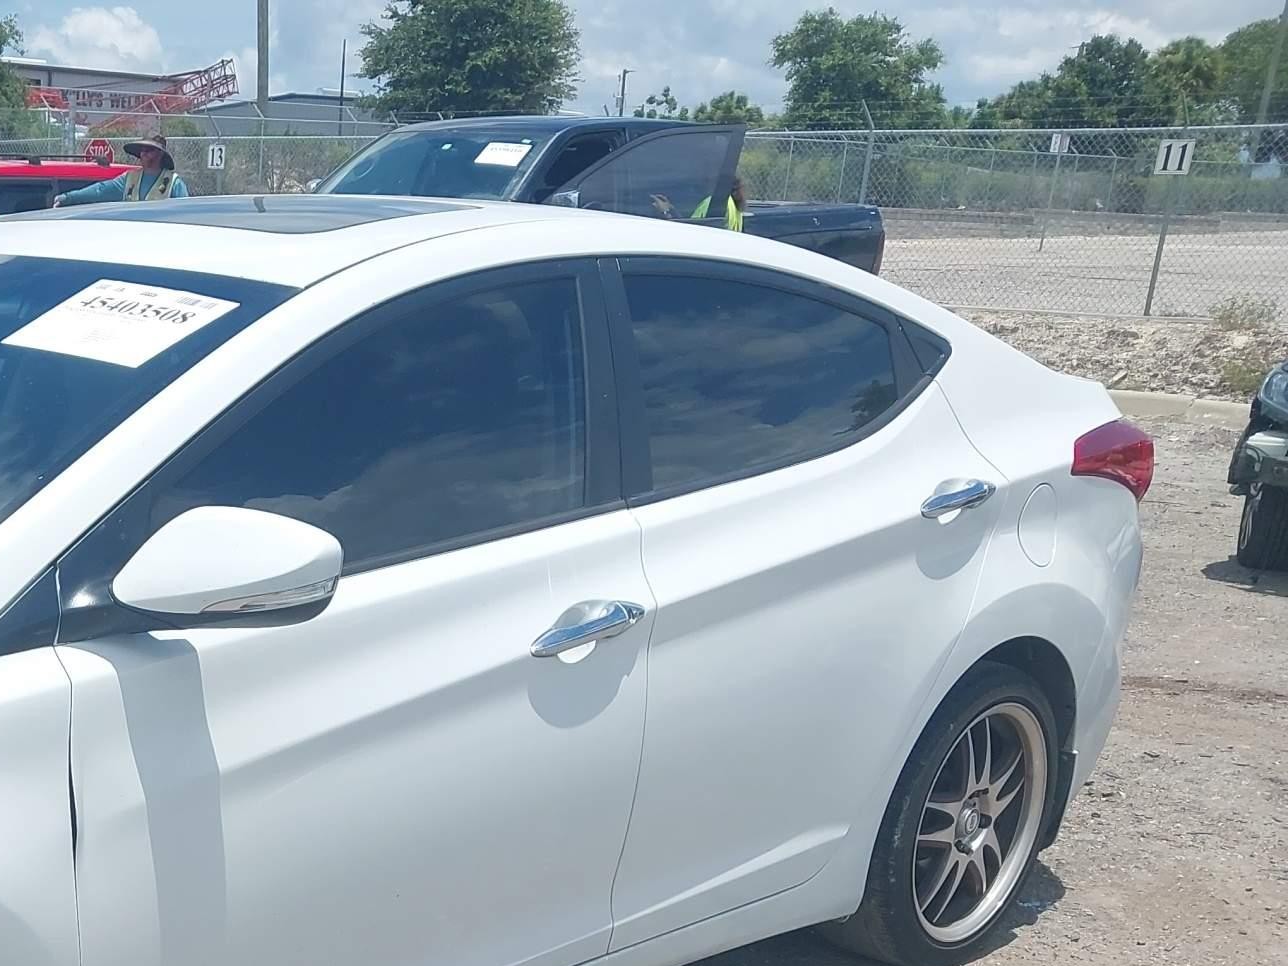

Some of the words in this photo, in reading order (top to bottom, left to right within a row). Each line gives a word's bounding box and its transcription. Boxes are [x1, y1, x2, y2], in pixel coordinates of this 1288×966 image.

[211, 147, 223, 167] 13
[1161, 142, 1188, 171] 11
[80, 295, 197, 325] 45403508
